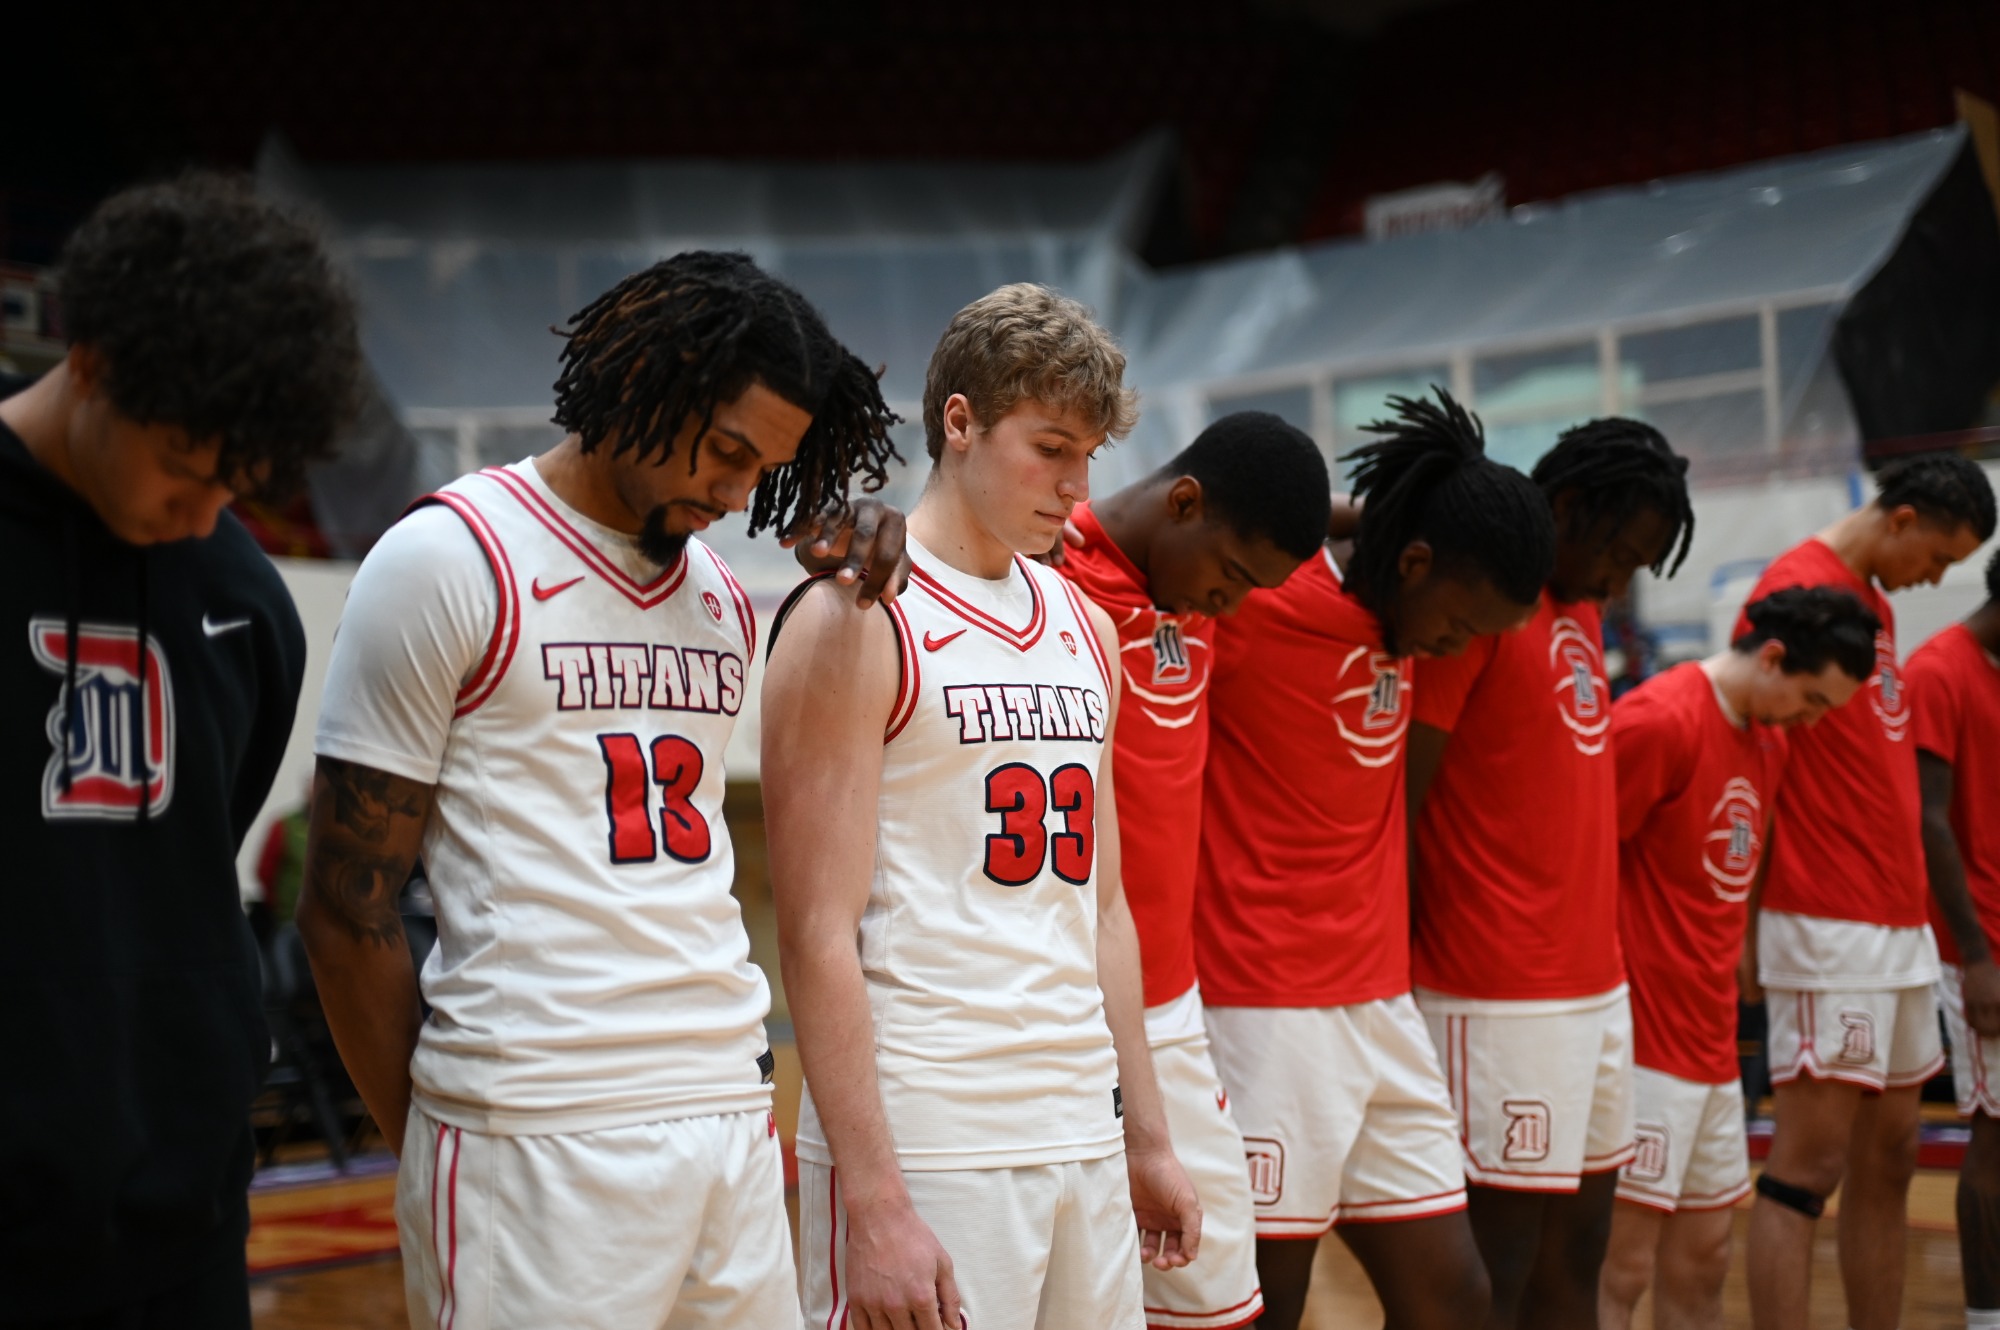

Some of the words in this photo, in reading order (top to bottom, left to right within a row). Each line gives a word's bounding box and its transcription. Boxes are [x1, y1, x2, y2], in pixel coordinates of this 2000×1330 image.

[541, 643, 744, 717] TITANS
[943, 684, 1105, 744] TITANS
[597, 733, 712, 865] 13
[983, 761, 1096, 887] 33
